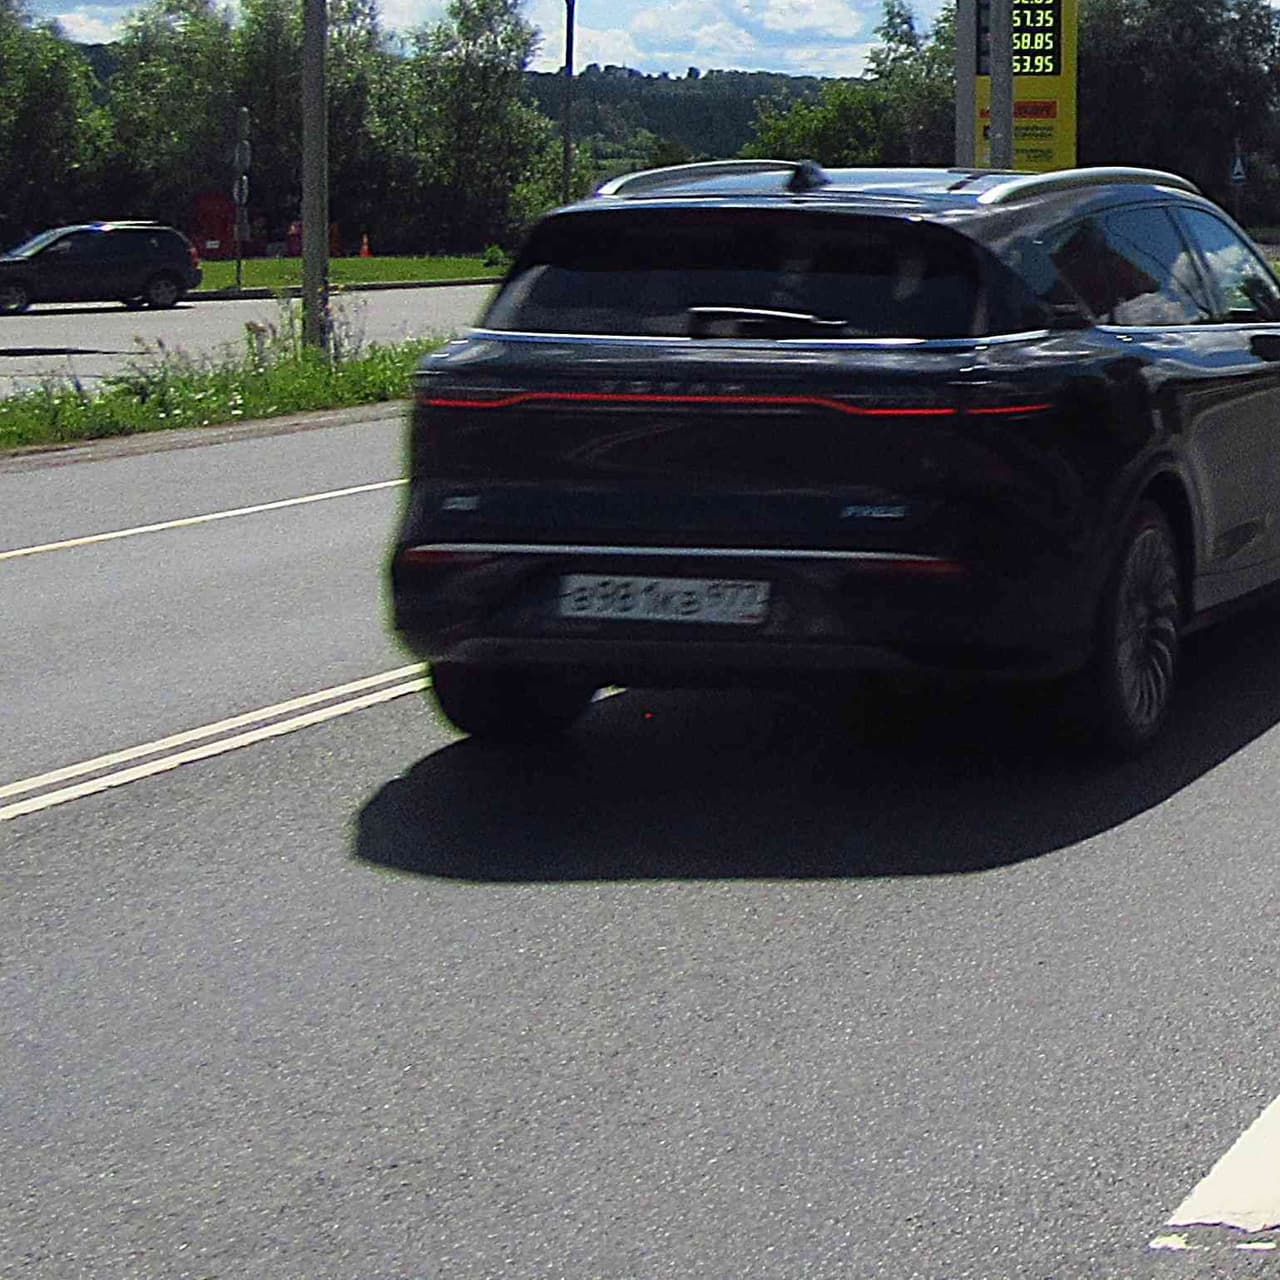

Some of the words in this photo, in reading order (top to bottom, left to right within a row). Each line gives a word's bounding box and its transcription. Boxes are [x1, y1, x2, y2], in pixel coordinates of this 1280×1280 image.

[1012, 10, 1054, 27] 57.35
[1012, 33, 1054, 50] 58.85
[1012, 55, 1054, 72] 53.95
